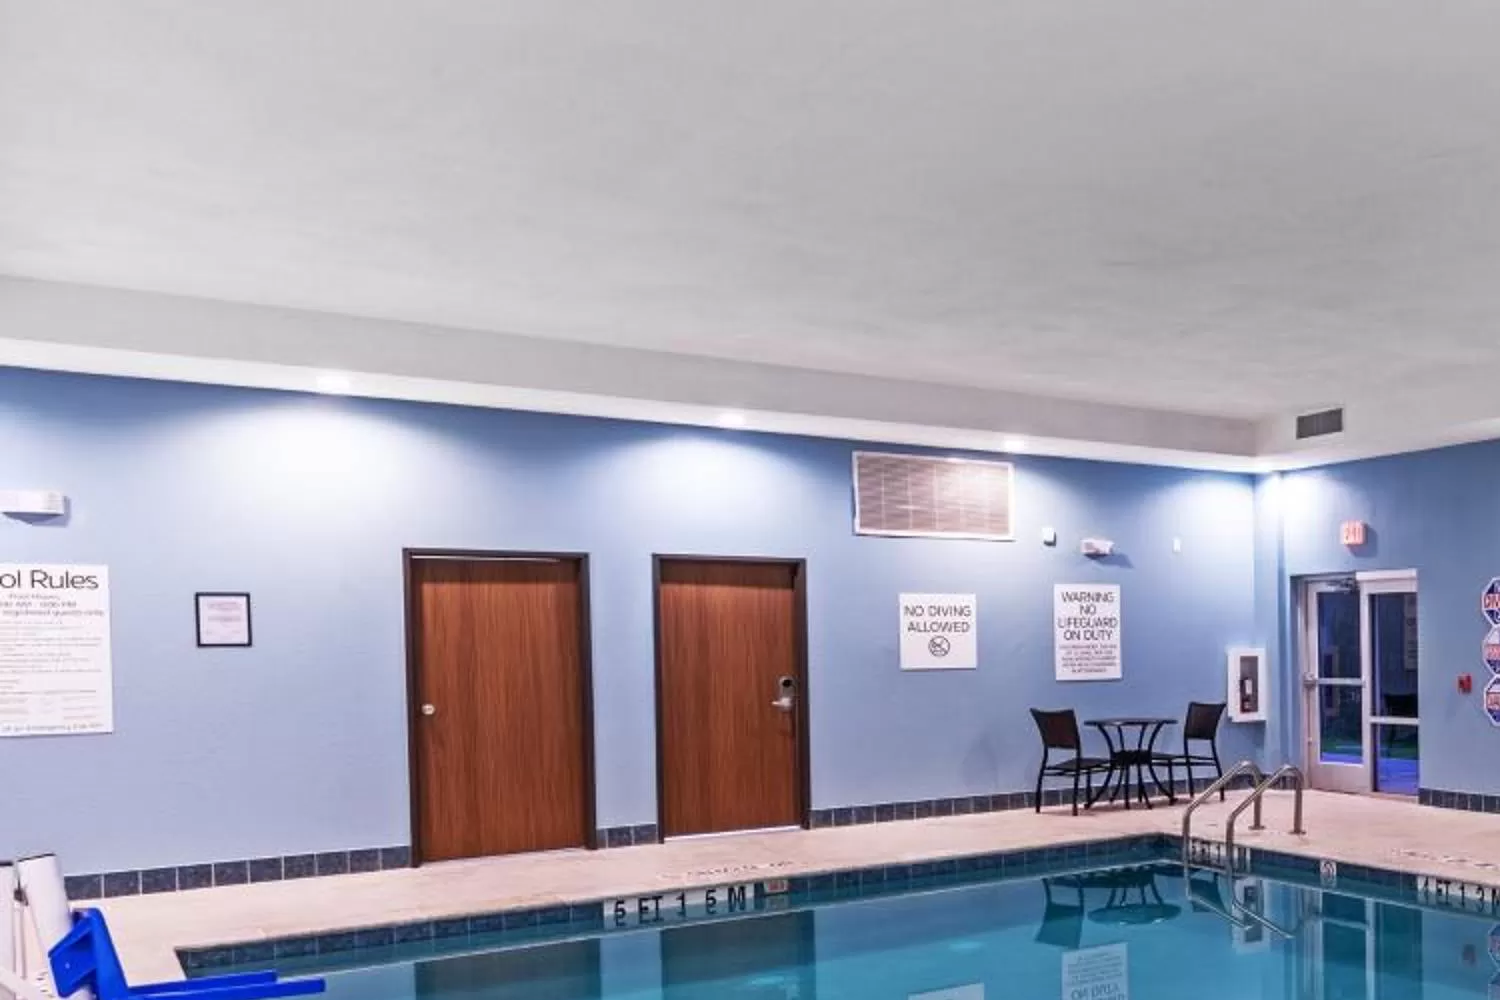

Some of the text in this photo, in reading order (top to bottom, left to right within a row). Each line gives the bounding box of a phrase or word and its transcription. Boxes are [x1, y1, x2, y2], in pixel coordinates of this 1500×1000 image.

[30, 569, 99, 590] Rules
[1061, 591, 1114, 603] WARNING
[904, 604, 972, 617] NO DIVING
[1080, 604, 1097, 615] NO
[907, 621, 971, 633] ALLOWED
[1057, 616, 1118, 629] LIFEGUARD
[1063, 629, 1113, 641] ON DUTY
